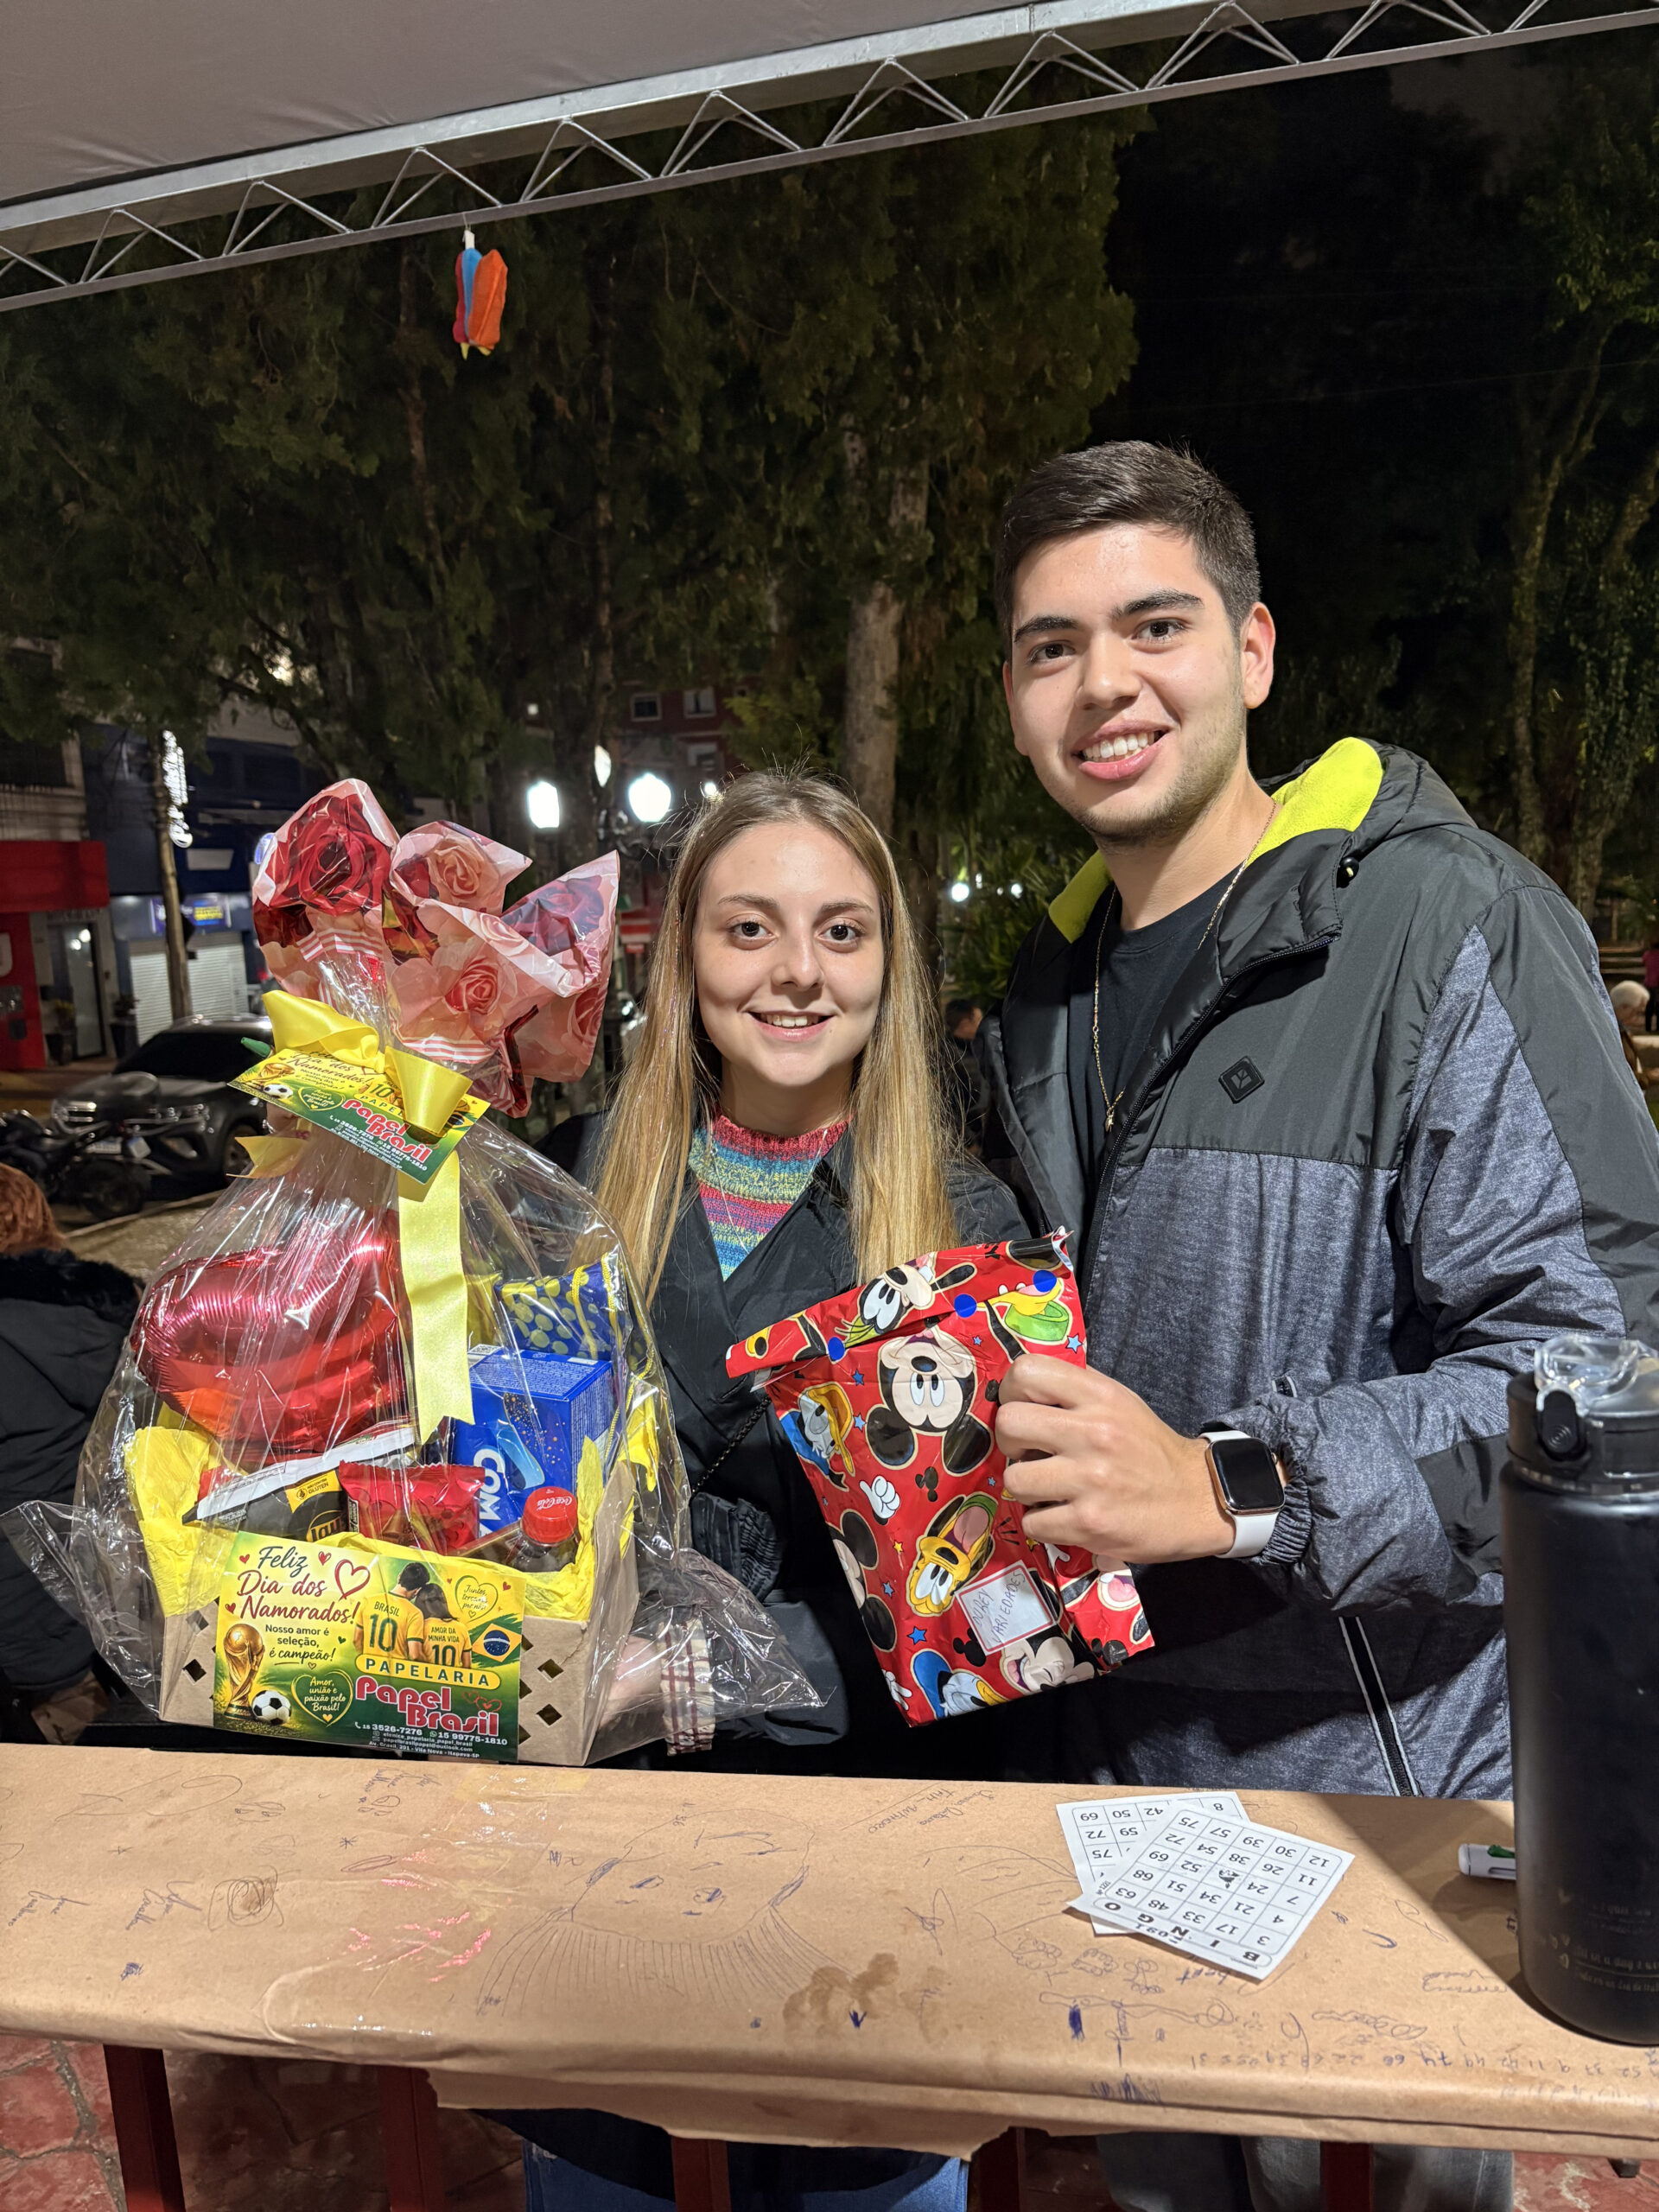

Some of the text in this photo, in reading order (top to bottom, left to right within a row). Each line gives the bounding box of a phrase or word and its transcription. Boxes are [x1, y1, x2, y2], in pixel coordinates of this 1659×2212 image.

[369, 1084, 394, 1097] 10
[341, 1099, 410, 1136] Papel
[366, 1122, 433, 1163] Brasil
[257, 1546, 308, 1578] Feliz
[237, 1569, 327, 1597] Dia dos
[240, 1595, 361, 1624] Namorados!
[374, 1601, 399, 1617] BRASIL
[265, 1624, 294, 1634] Nosso
[277, 1636, 320, 1648] seleção,
[369, 1613, 397, 1652] 10
[270, 1648, 336, 1664] é campeão!
[432, 1644, 456, 1667] 10
[310, 1676, 334, 1687] Amor,
[365, 1658, 489, 1687] PAPELARIA
[304, 1694, 346, 1706] paixão pelo
[309, 1685, 331, 1694] união
[356, 1675, 451, 1713] Papel
[312, 1702, 340, 1712] Brasil!
[372, 1724, 423, 1735] 3526-7276
[452, 1733, 508, 1745] 99775-1810
[406, 1710, 499, 1737] Brasil
[1080, 1802, 1224, 1821] 8 42 50 69
[1085, 1827, 1139, 1840] 59 72
[1179, 1816, 1331, 1867] 12 30 39 57 75
[1091, 1848, 1113, 1859] 75
[1165, 1833, 1318, 1885] 11 26 38 54 72
[1148, 1850, 1300, 1904] 7 24 52 69
[1133, 1869, 1285, 1925] 4 21 34 51 68
[1116, 1887, 1270, 1946] 3 17 33 48 63
[1104, 1902, 1261, 1961] B I N G O
